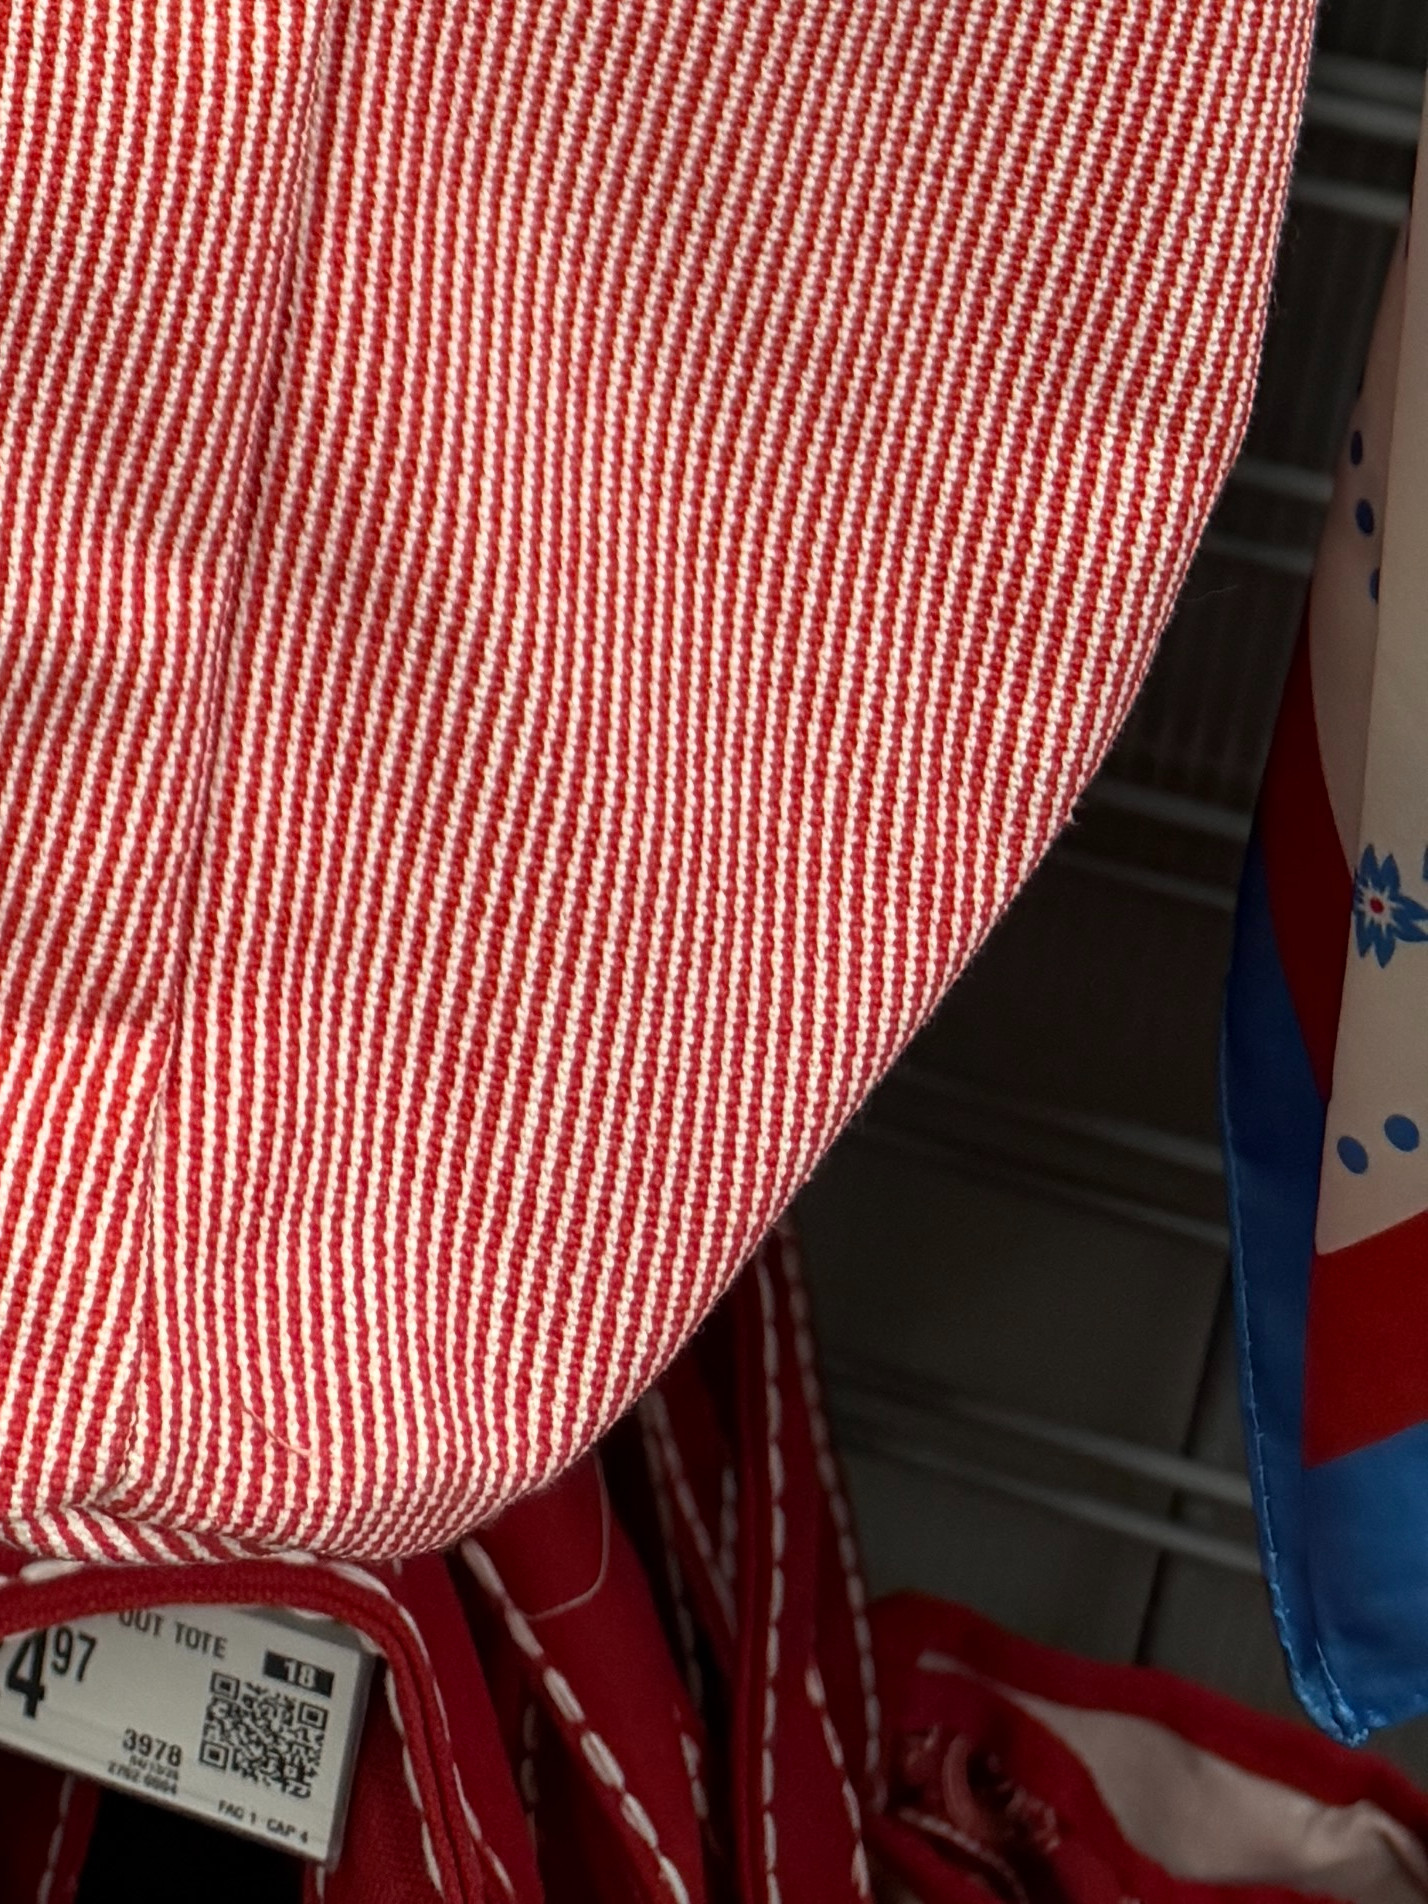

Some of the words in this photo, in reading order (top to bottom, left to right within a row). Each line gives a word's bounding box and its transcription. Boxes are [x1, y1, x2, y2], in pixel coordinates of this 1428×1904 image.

[51, 1625, 98, 1683] 97
[174, 1621, 228, 1659] TOTE
[282, 1658, 317, 1689] 18
[122, 1727, 183, 1767] 3978
[265, 1817, 297, 1837] CAP
